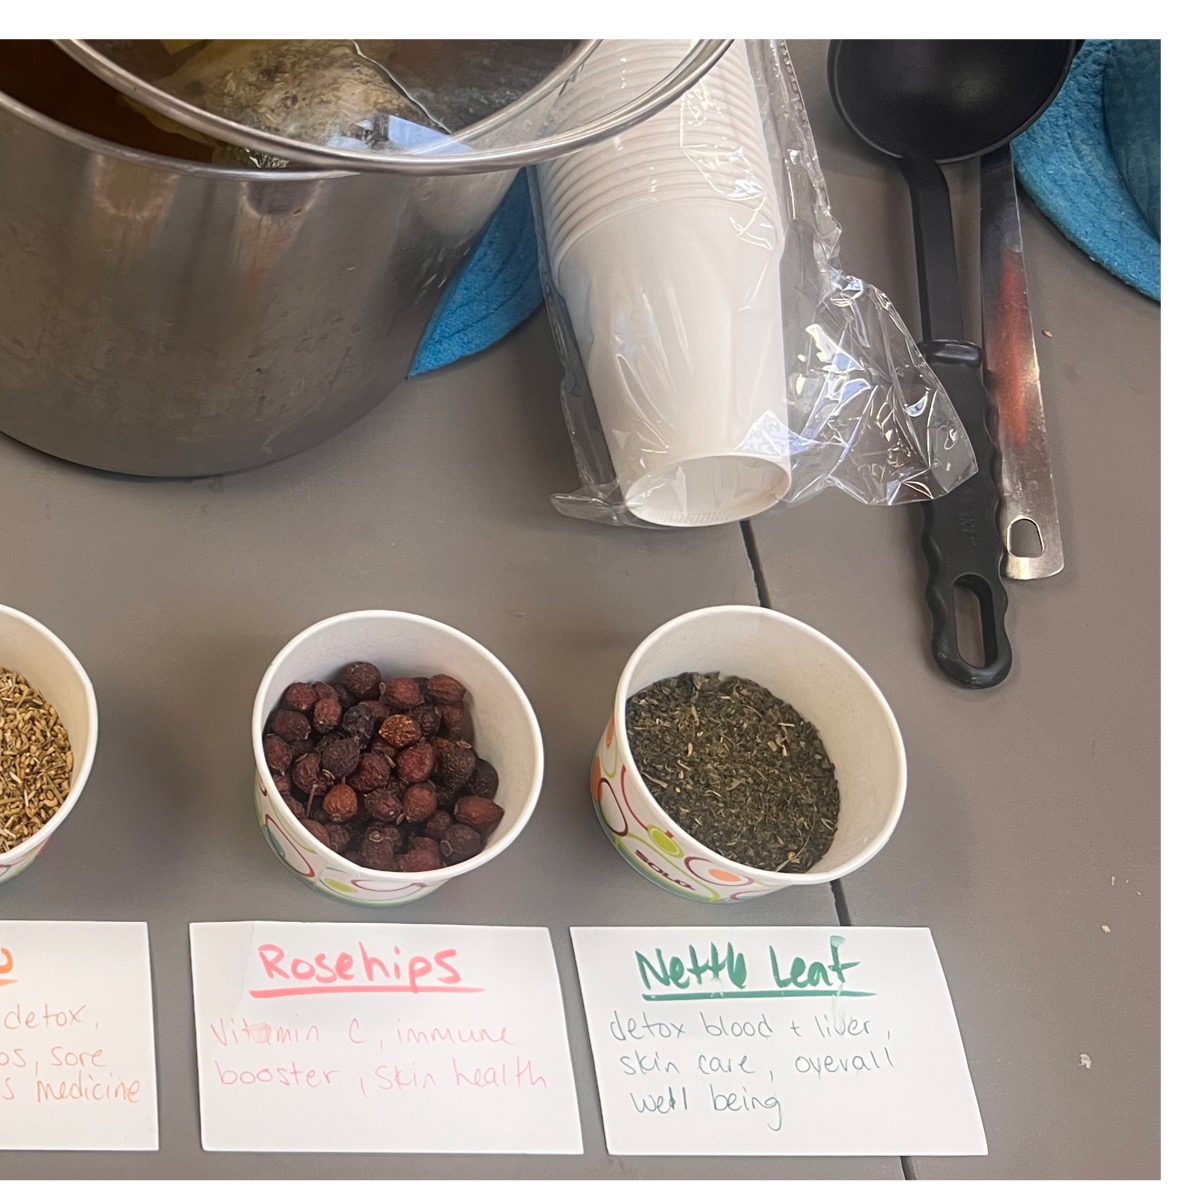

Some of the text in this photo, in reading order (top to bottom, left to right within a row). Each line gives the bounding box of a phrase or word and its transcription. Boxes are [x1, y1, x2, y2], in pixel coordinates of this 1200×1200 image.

[634, 849, 696, 891] SOLO
[257, 941, 462, 993] Rosehips
[769, 935, 860, 989] Leaf
[396, 1017, 516, 1046] immune
[609, 1011, 686, 1042] detox
[700, 1011, 773, 1039] blood
[452, 1056, 548, 1090] health
[620, 1050, 680, 1075] skin
[36, 1072, 141, 1104] medicine
[710, 1084, 783, 1131] being
